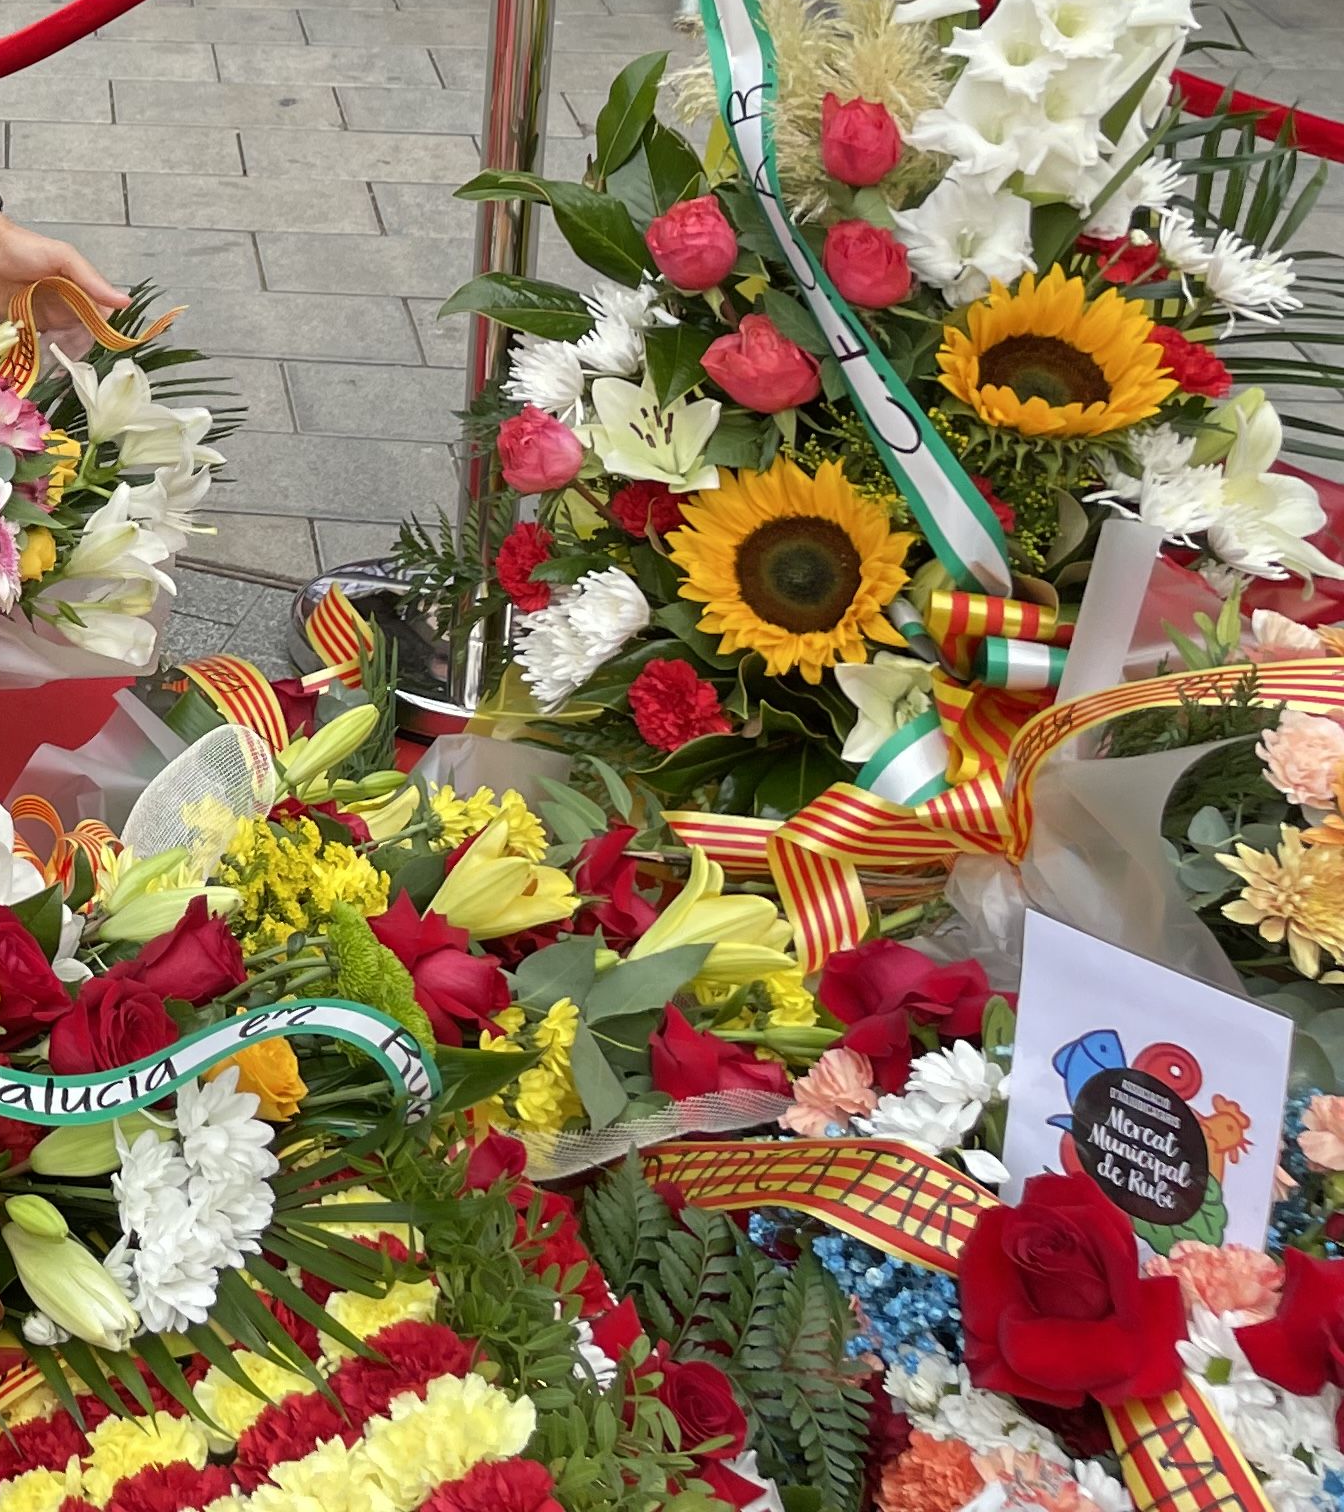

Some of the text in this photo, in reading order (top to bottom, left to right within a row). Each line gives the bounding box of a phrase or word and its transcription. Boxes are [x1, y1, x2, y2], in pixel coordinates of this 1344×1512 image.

[1088, 1122, 1192, 1188] Municipal
[1106, 1106, 1180, 1157] Mercat
[1097, 1152, 1126, 1186] de
